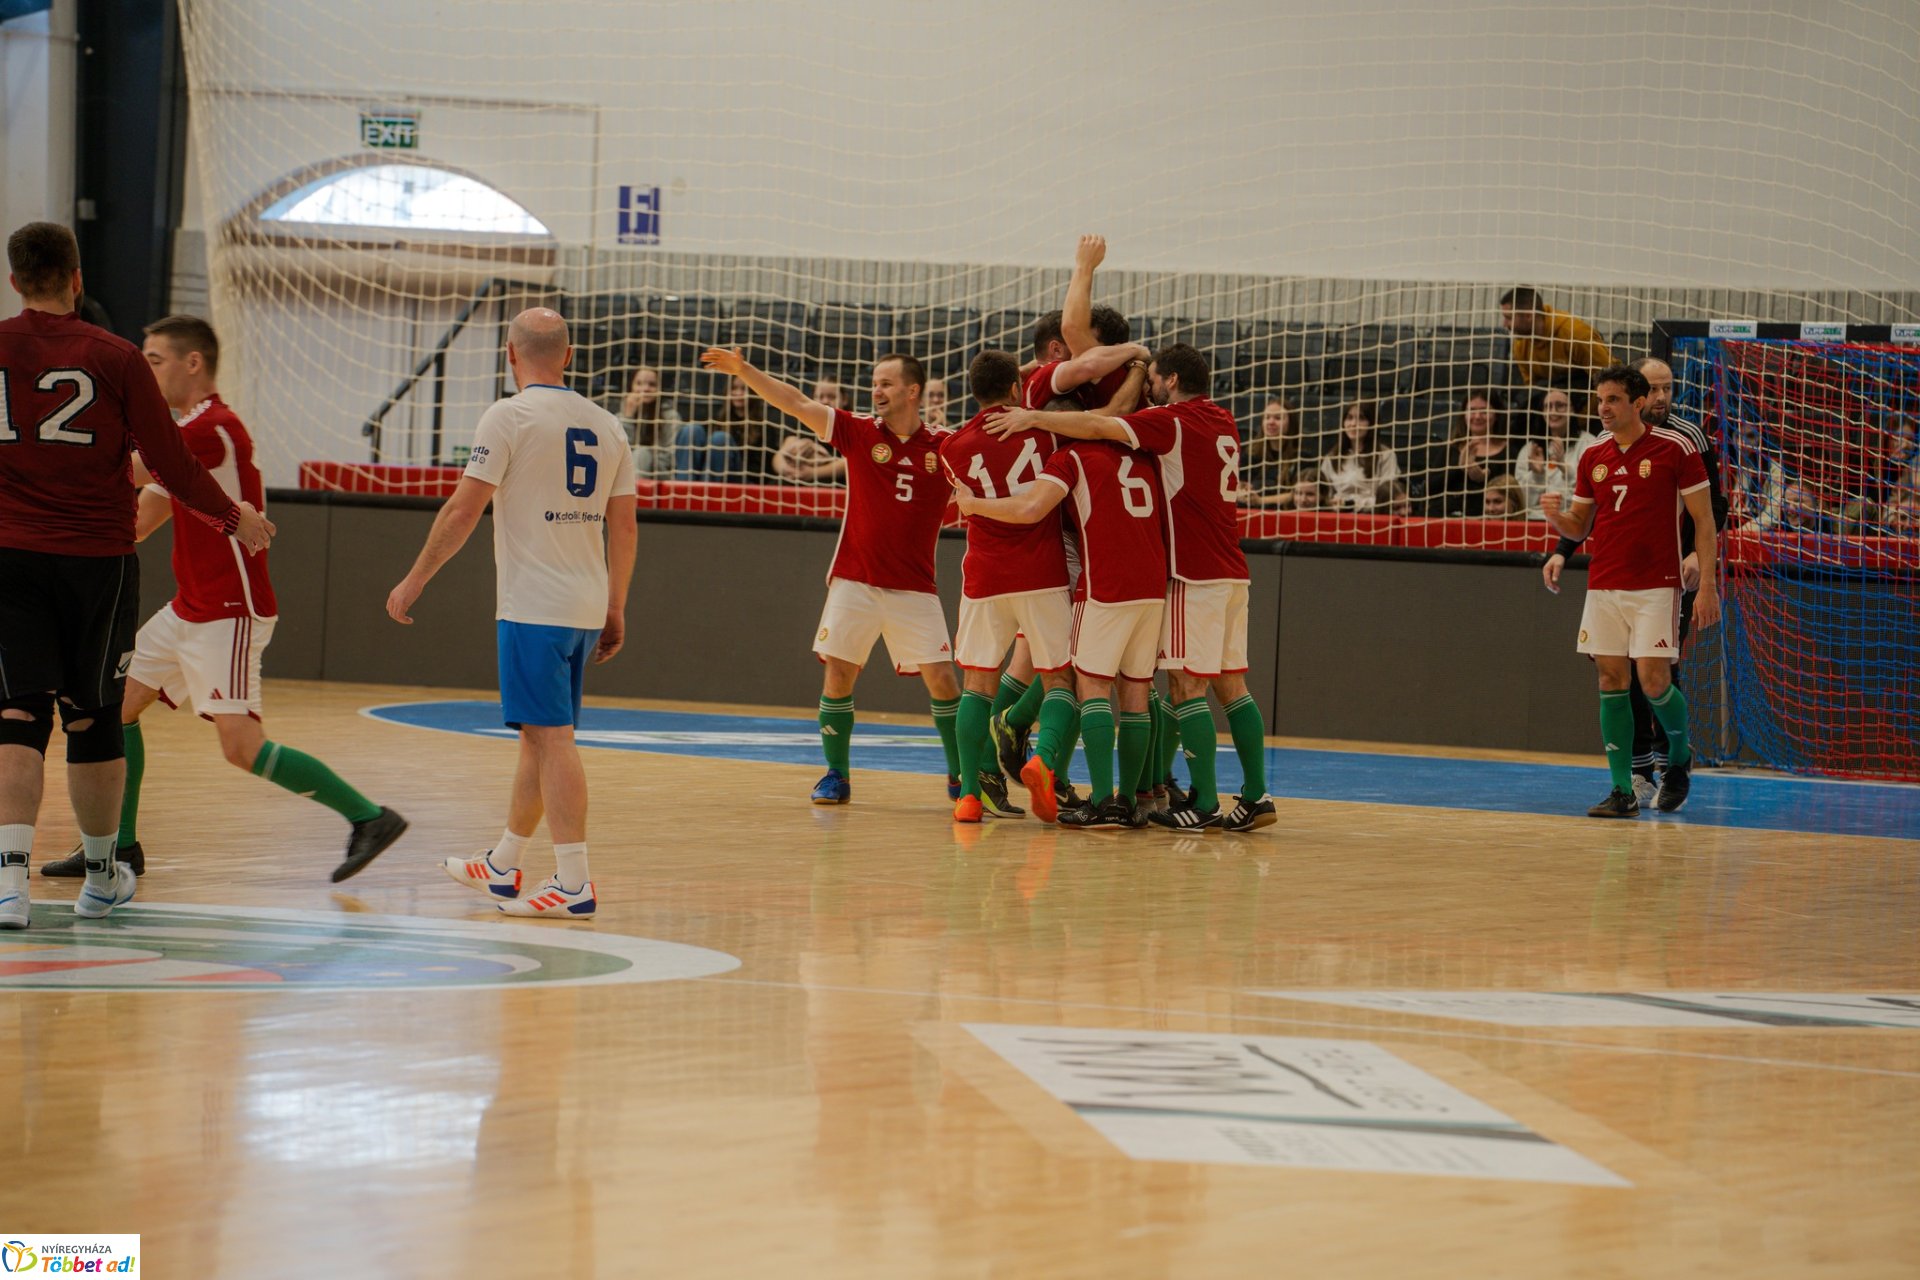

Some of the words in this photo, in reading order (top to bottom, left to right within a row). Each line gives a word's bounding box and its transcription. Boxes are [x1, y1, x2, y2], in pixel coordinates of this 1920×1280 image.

[366, 124, 412, 145] EXIT
[0, 367, 97, 446] 12
[566, 427, 598, 498] 6
[895, 473, 914, 502] 5
[968, 436, 1045, 499] 14
[1117, 455, 1154, 518] 6
[1216, 435, 1239, 502] 8
[1612, 485, 1628, 512] 7
